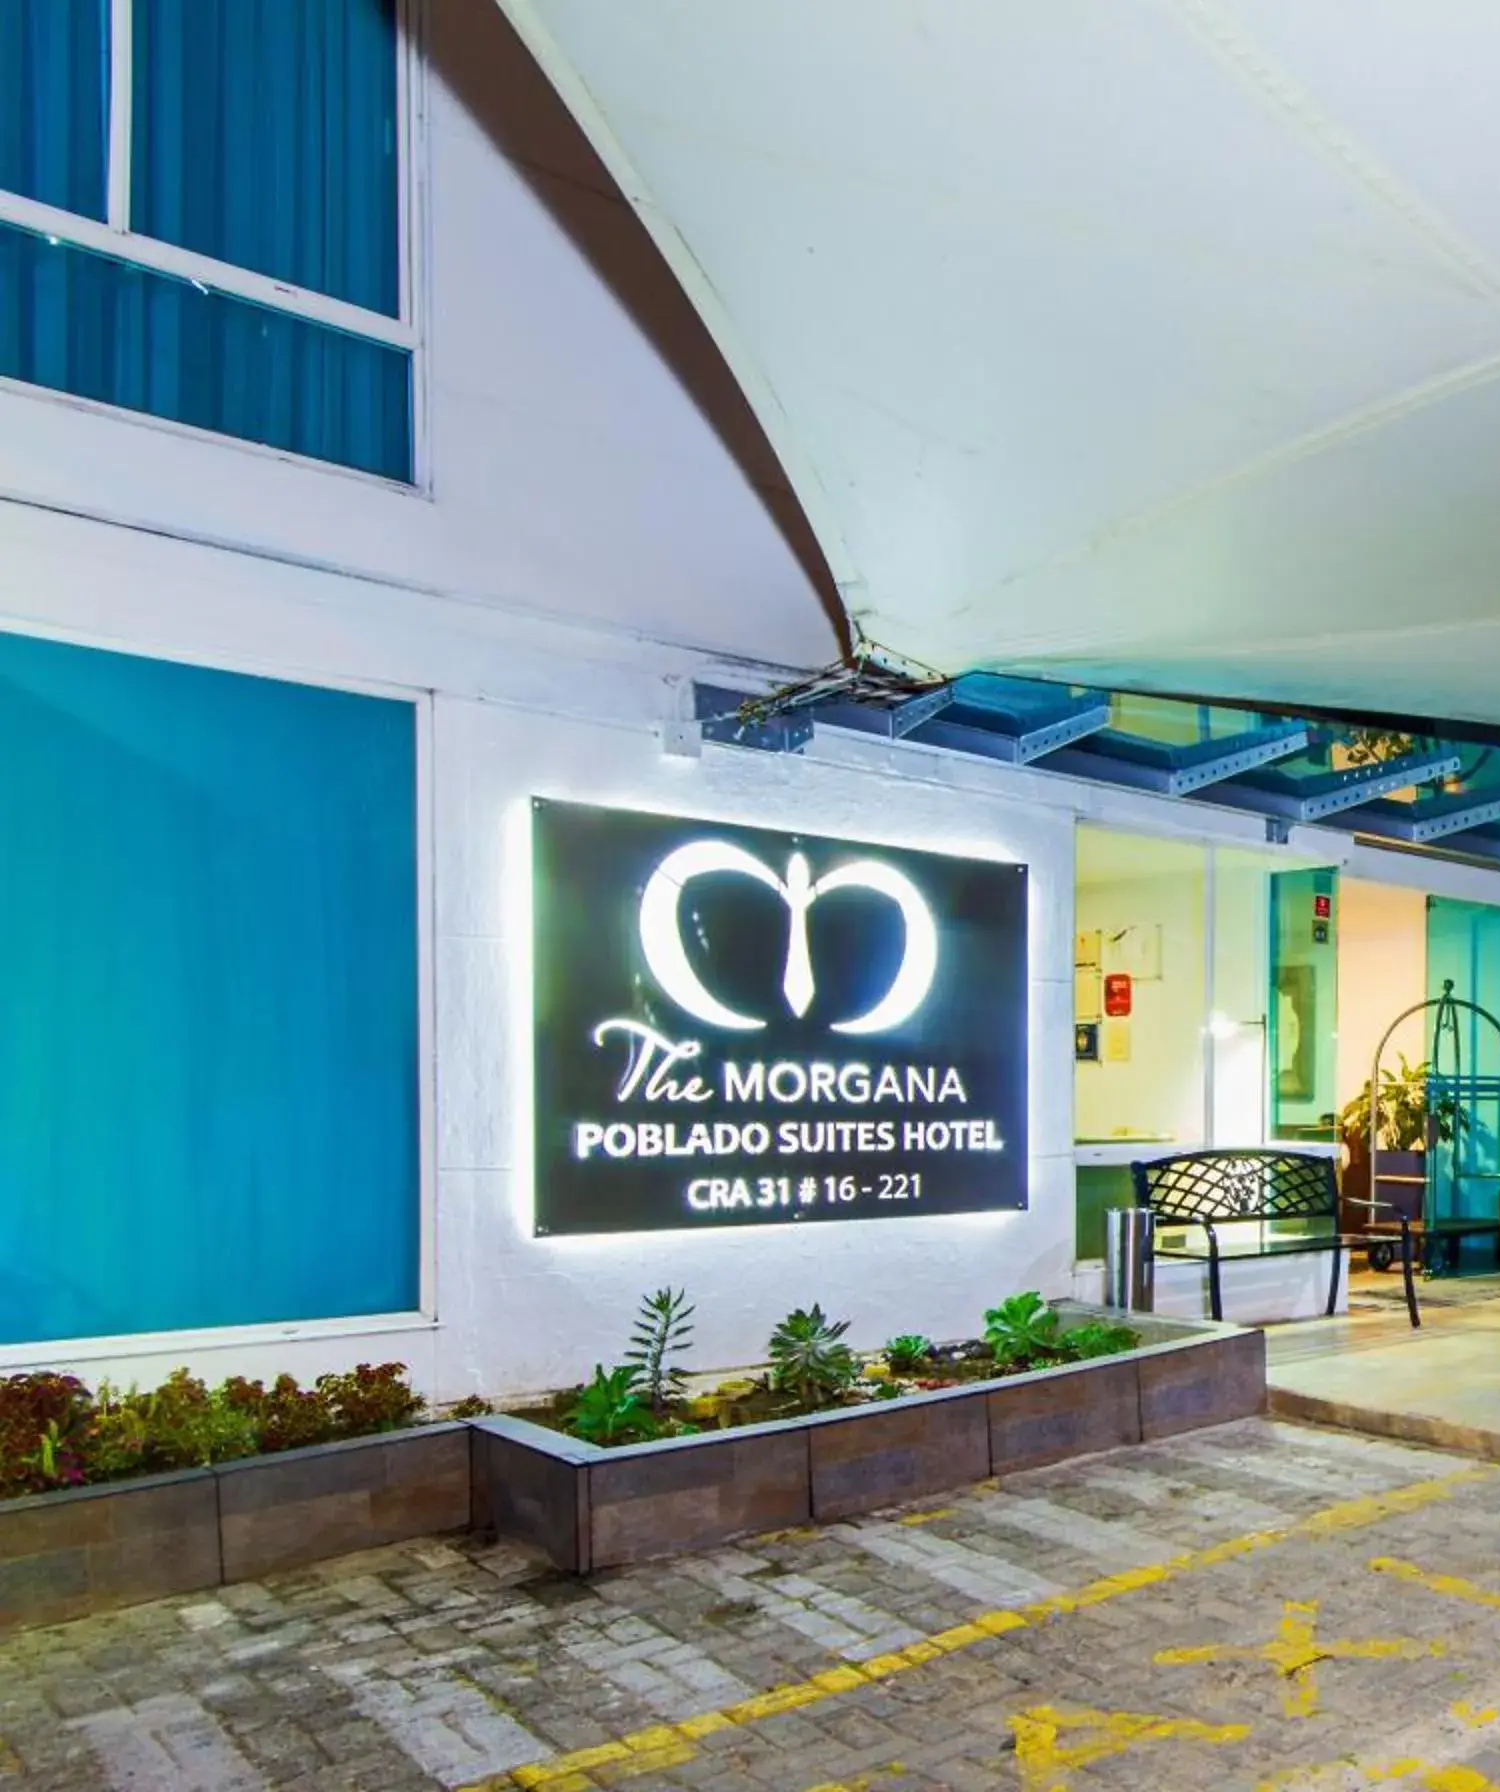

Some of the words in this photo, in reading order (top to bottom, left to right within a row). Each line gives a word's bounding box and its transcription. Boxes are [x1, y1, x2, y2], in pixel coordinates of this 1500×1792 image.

[593, 1015, 714, 1103] The
[723, 1061, 967, 1104] MORGANA
[575, 1121, 770, 1160] POBLADO
[778, 1121, 896, 1154] SUITES
[903, 1119, 1005, 1152] HOTEL
[686, 1176, 752, 1211] CRA
[756, 1177, 791, 1208] 31
[798, 1175, 817, 1204] #
[824, 1174, 857, 1203] 16
[878, 1173, 921, 1199] 221
